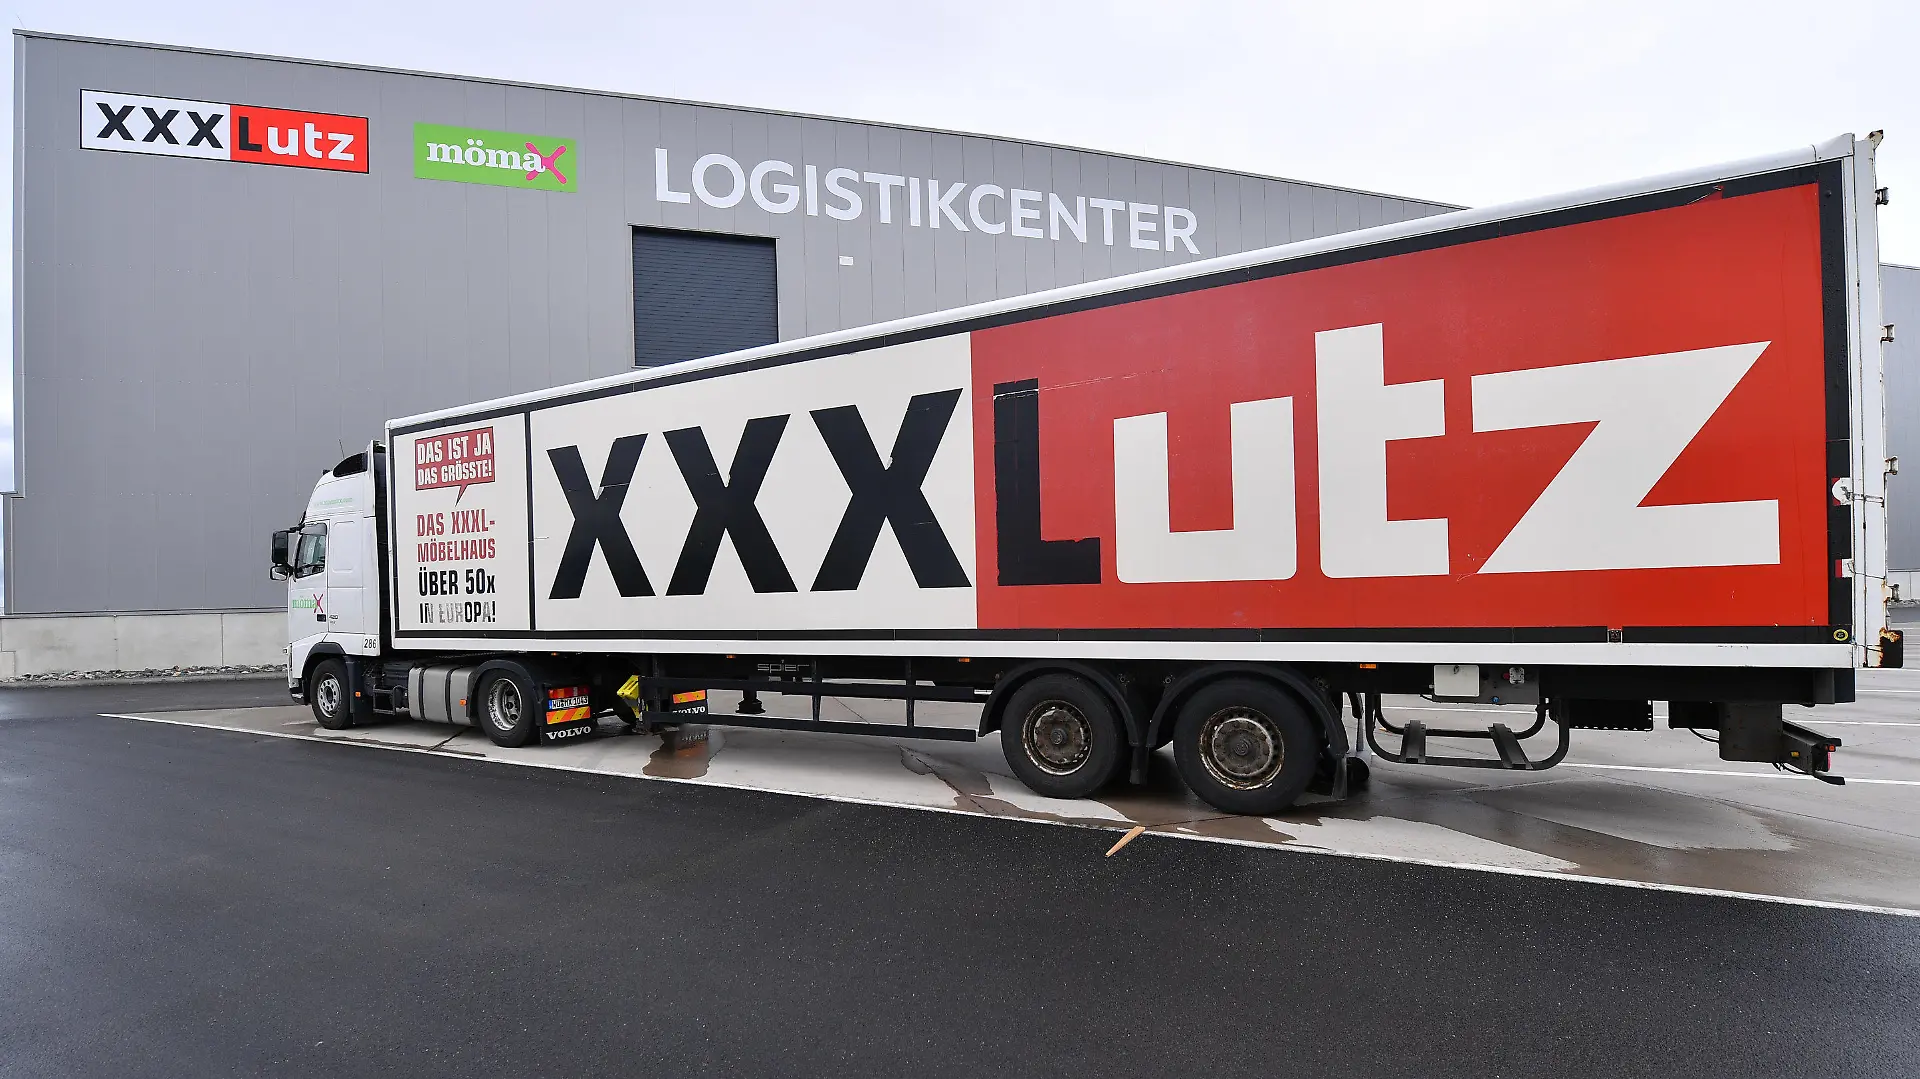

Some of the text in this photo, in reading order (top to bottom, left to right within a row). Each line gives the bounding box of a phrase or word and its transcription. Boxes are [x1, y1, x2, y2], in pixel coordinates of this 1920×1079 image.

[96, 102, 355, 162] XXXLutz
[655, 147, 1201, 255] LOGISTIKCENTER
[417, 432, 492, 465] DAS IST JA
[546, 322, 1781, 600] XXXLutz
[417, 459, 493, 486] DAS GRÖSSTE!
[416, 508, 496, 537] DAS XXXL-
[417, 538, 496, 563] MÖBELHAUS
[418, 566, 459, 597] ÜBER
[419, 602, 434, 623] IN
[363, 638, 377, 649] 286
[757, 659, 810, 673] spier
[546, 726, 591, 740] VOLVO
